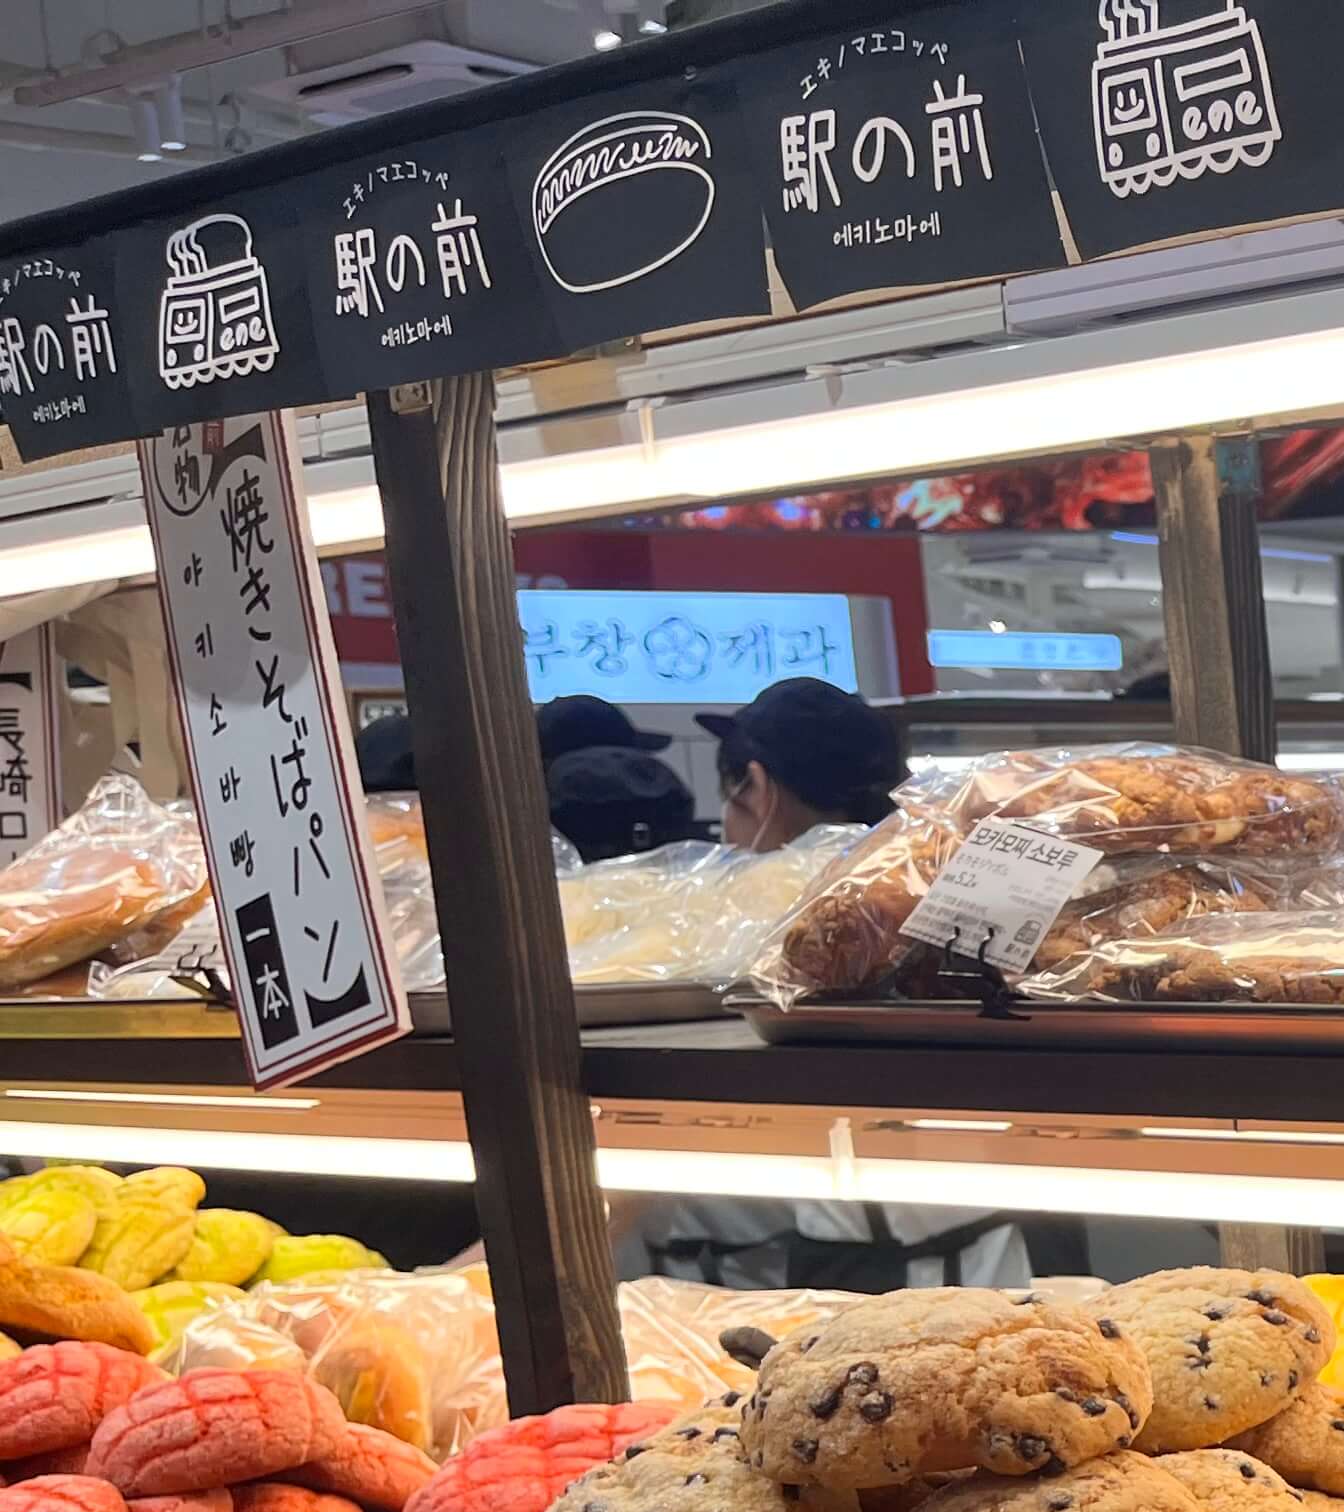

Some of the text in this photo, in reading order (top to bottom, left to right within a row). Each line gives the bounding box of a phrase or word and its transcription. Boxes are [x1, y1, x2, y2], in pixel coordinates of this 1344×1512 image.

[780, 74, 992, 213] 駅の前
[334, 199, 492, 318] 駅の前
[833, 211, 942, 248] 에키노마에
[0, 259, 81, 301] キノマエコッペ
[0, 295, 117, 396] 駅の前
[380, 314, 453, 348] 에키노마에
[32, 395, 88, 424] 에키노마에
[718, 622, 837, 676] 제과
[221, 468, 339, 984] 焼きそばパン
[246, 926, 291, 1021] 一本
